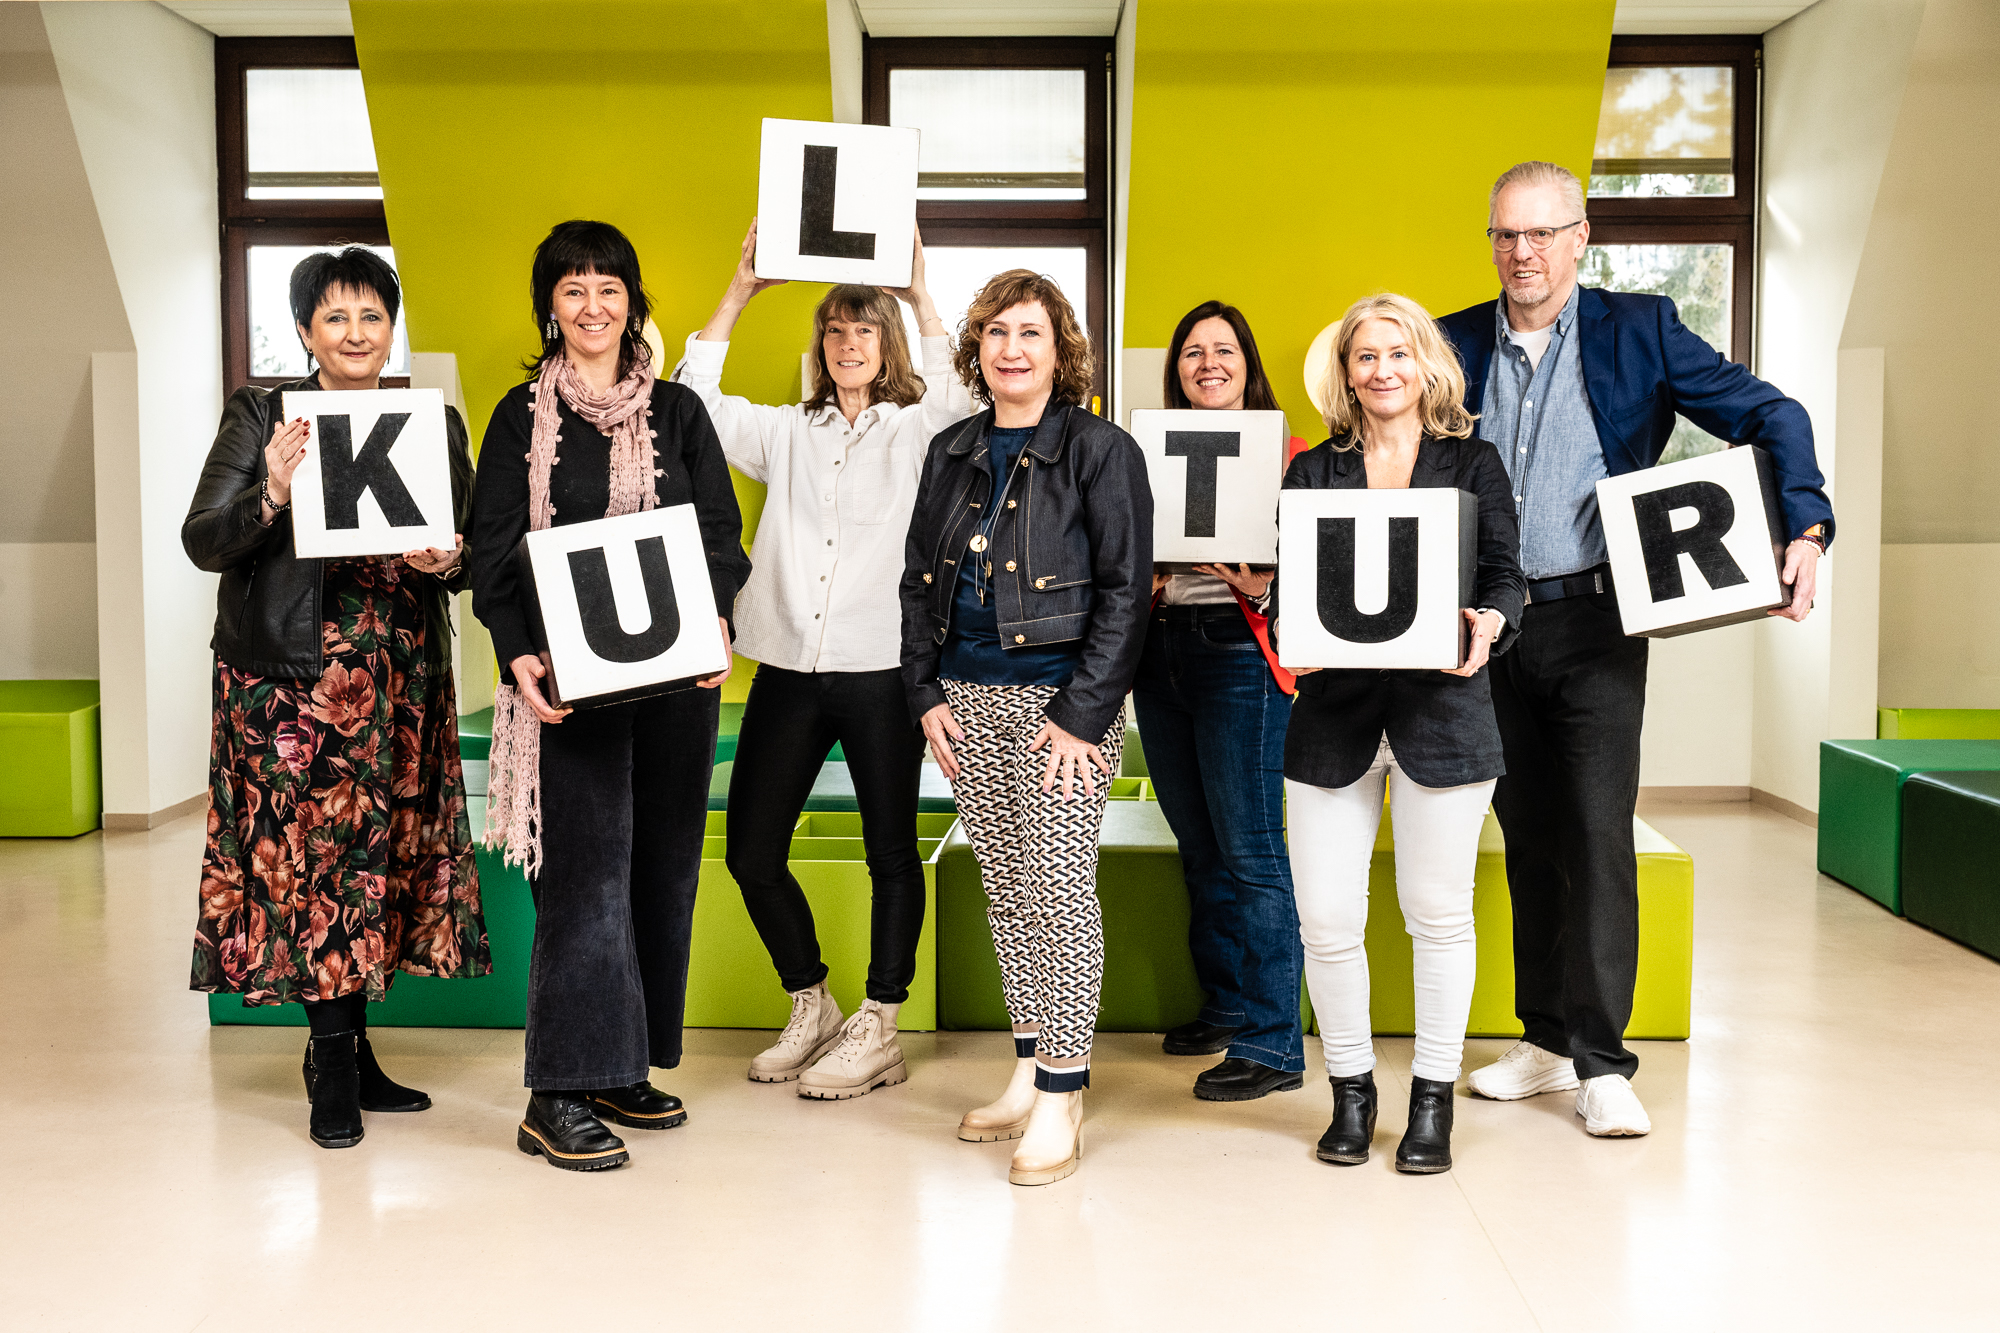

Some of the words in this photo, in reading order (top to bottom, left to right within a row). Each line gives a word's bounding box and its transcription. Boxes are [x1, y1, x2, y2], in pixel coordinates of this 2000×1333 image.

[799, 145, 876, 260] L
[317, 413, 427, 530] K
[1165, 431, 1241, 537] T
[567, 536, 680, 663] U
[1317, 517, 1418, 643] U
[1632, 481, 1749, 603] R
